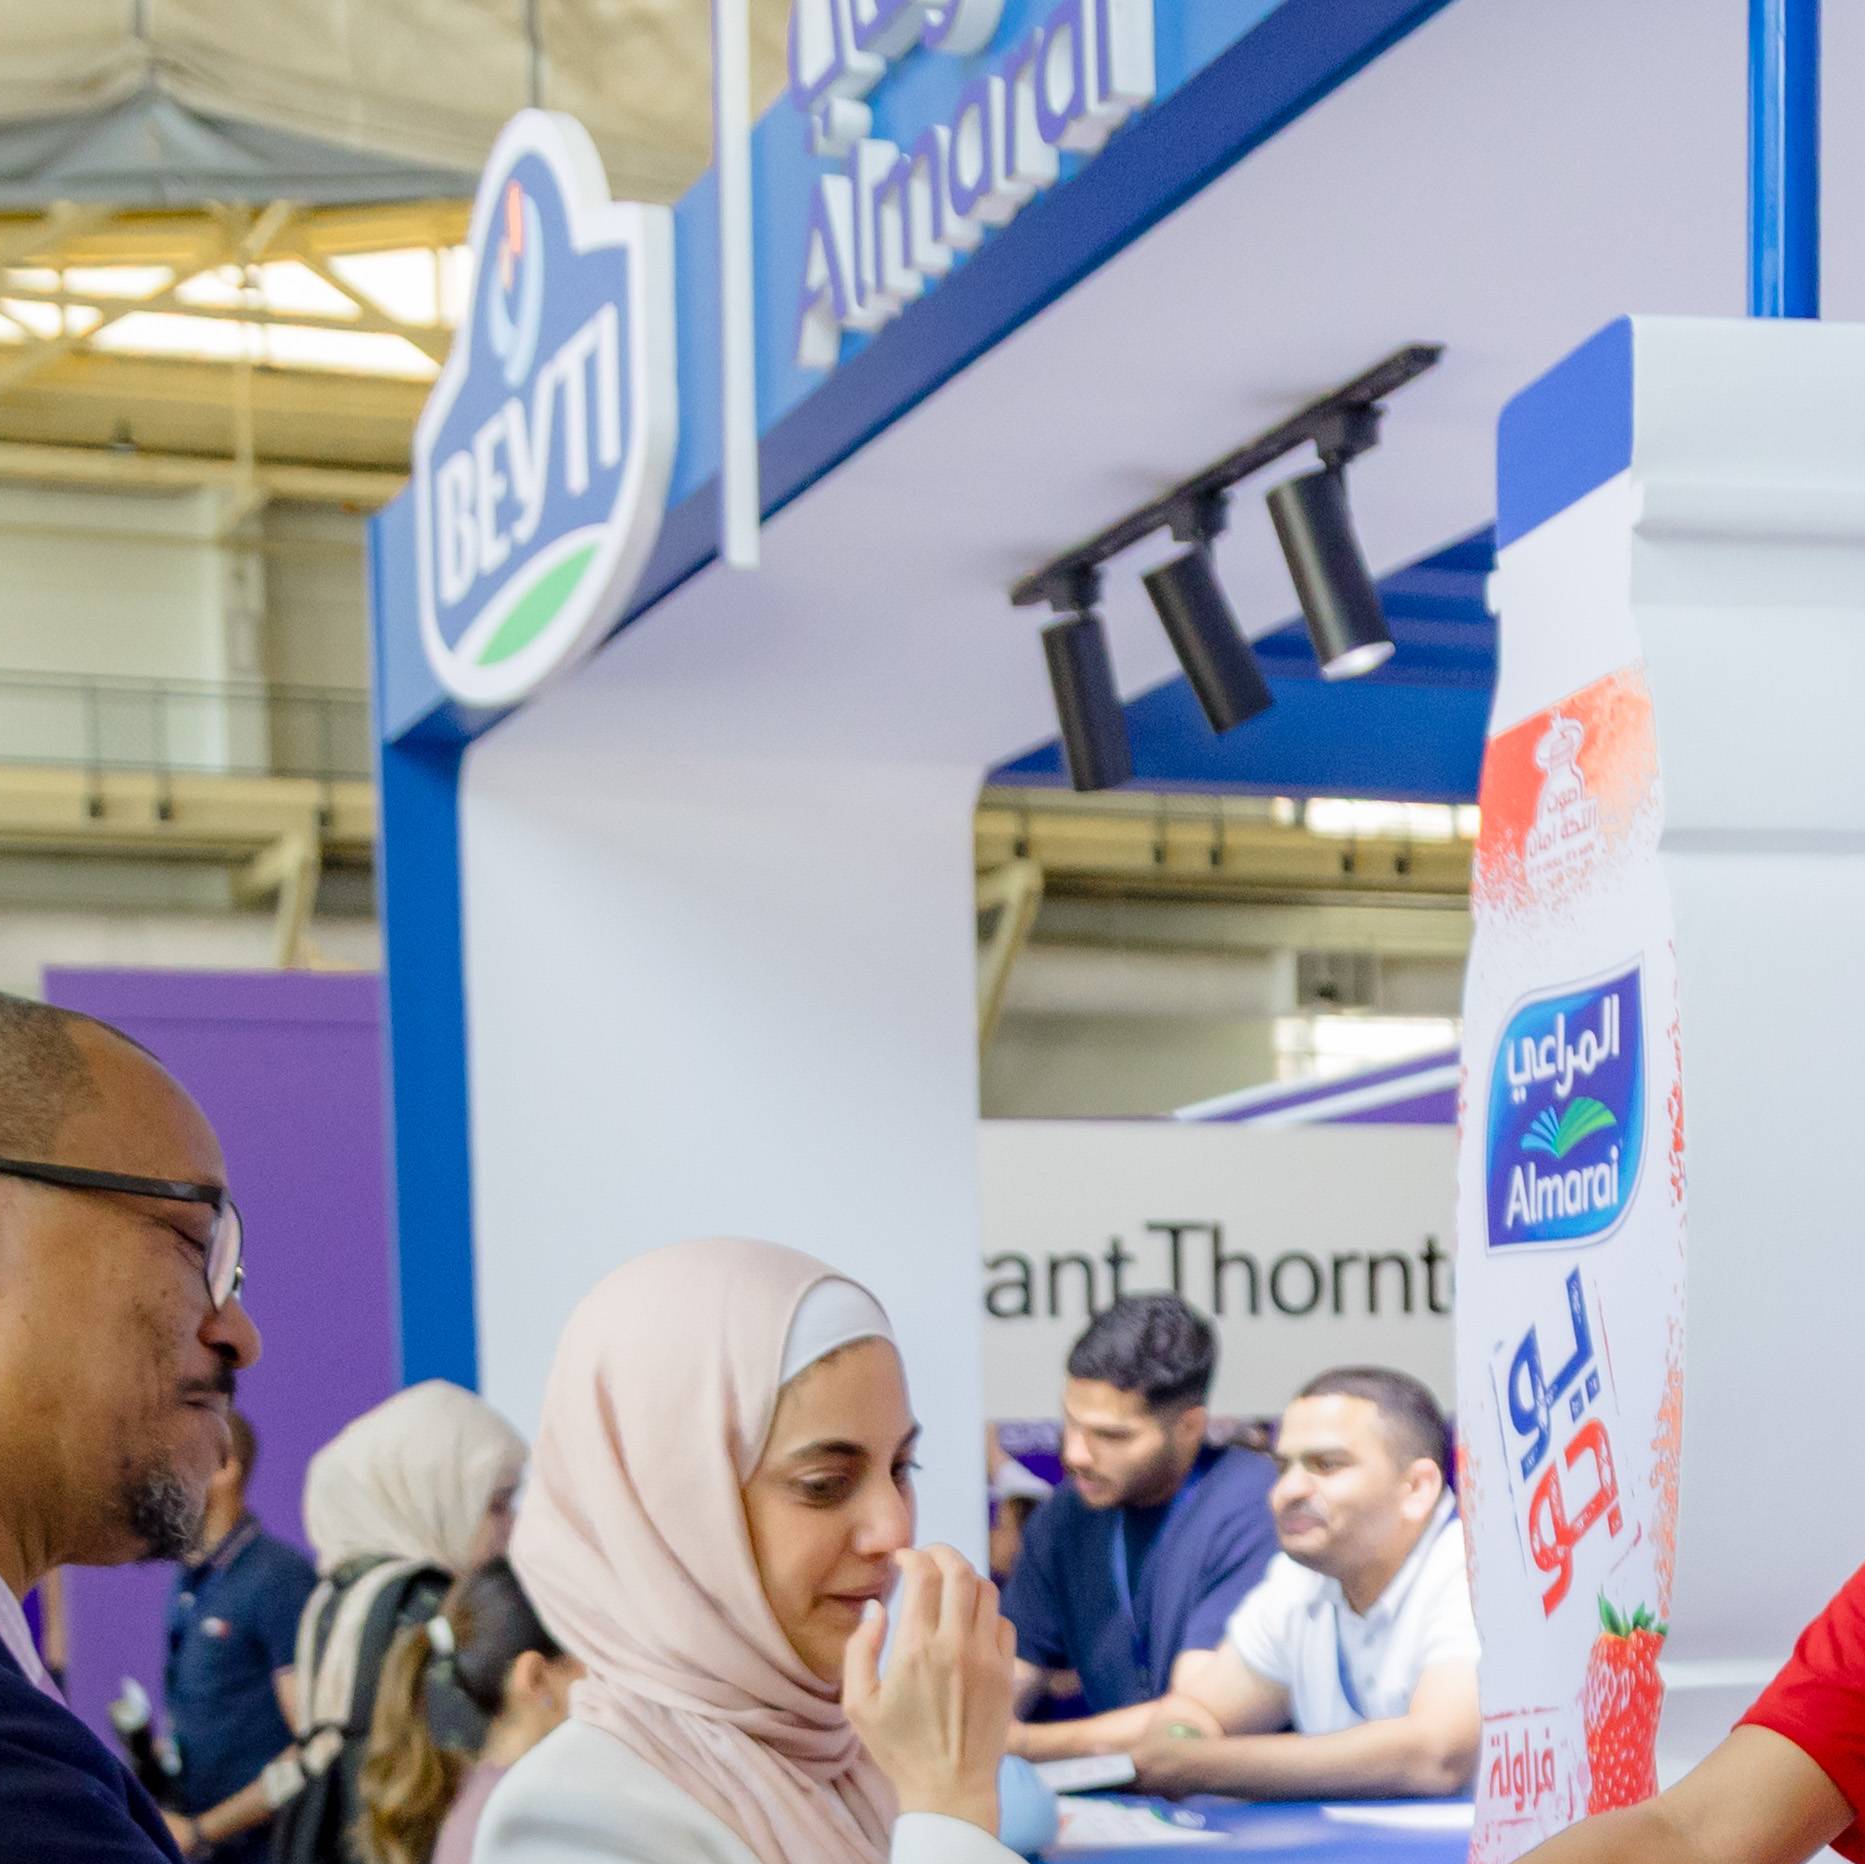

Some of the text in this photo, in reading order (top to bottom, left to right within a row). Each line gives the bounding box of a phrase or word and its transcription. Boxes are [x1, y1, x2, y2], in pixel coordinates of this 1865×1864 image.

[438, 303, 622, 606] BEYTI
[1506, 994, 1620, 1103] المراعي
[1506, 1145, 1620, 1228] Almarai
[985, 1219, 1455, 1318] ant Thornt
[1489, 1727, 1556, 1812] فراولة
